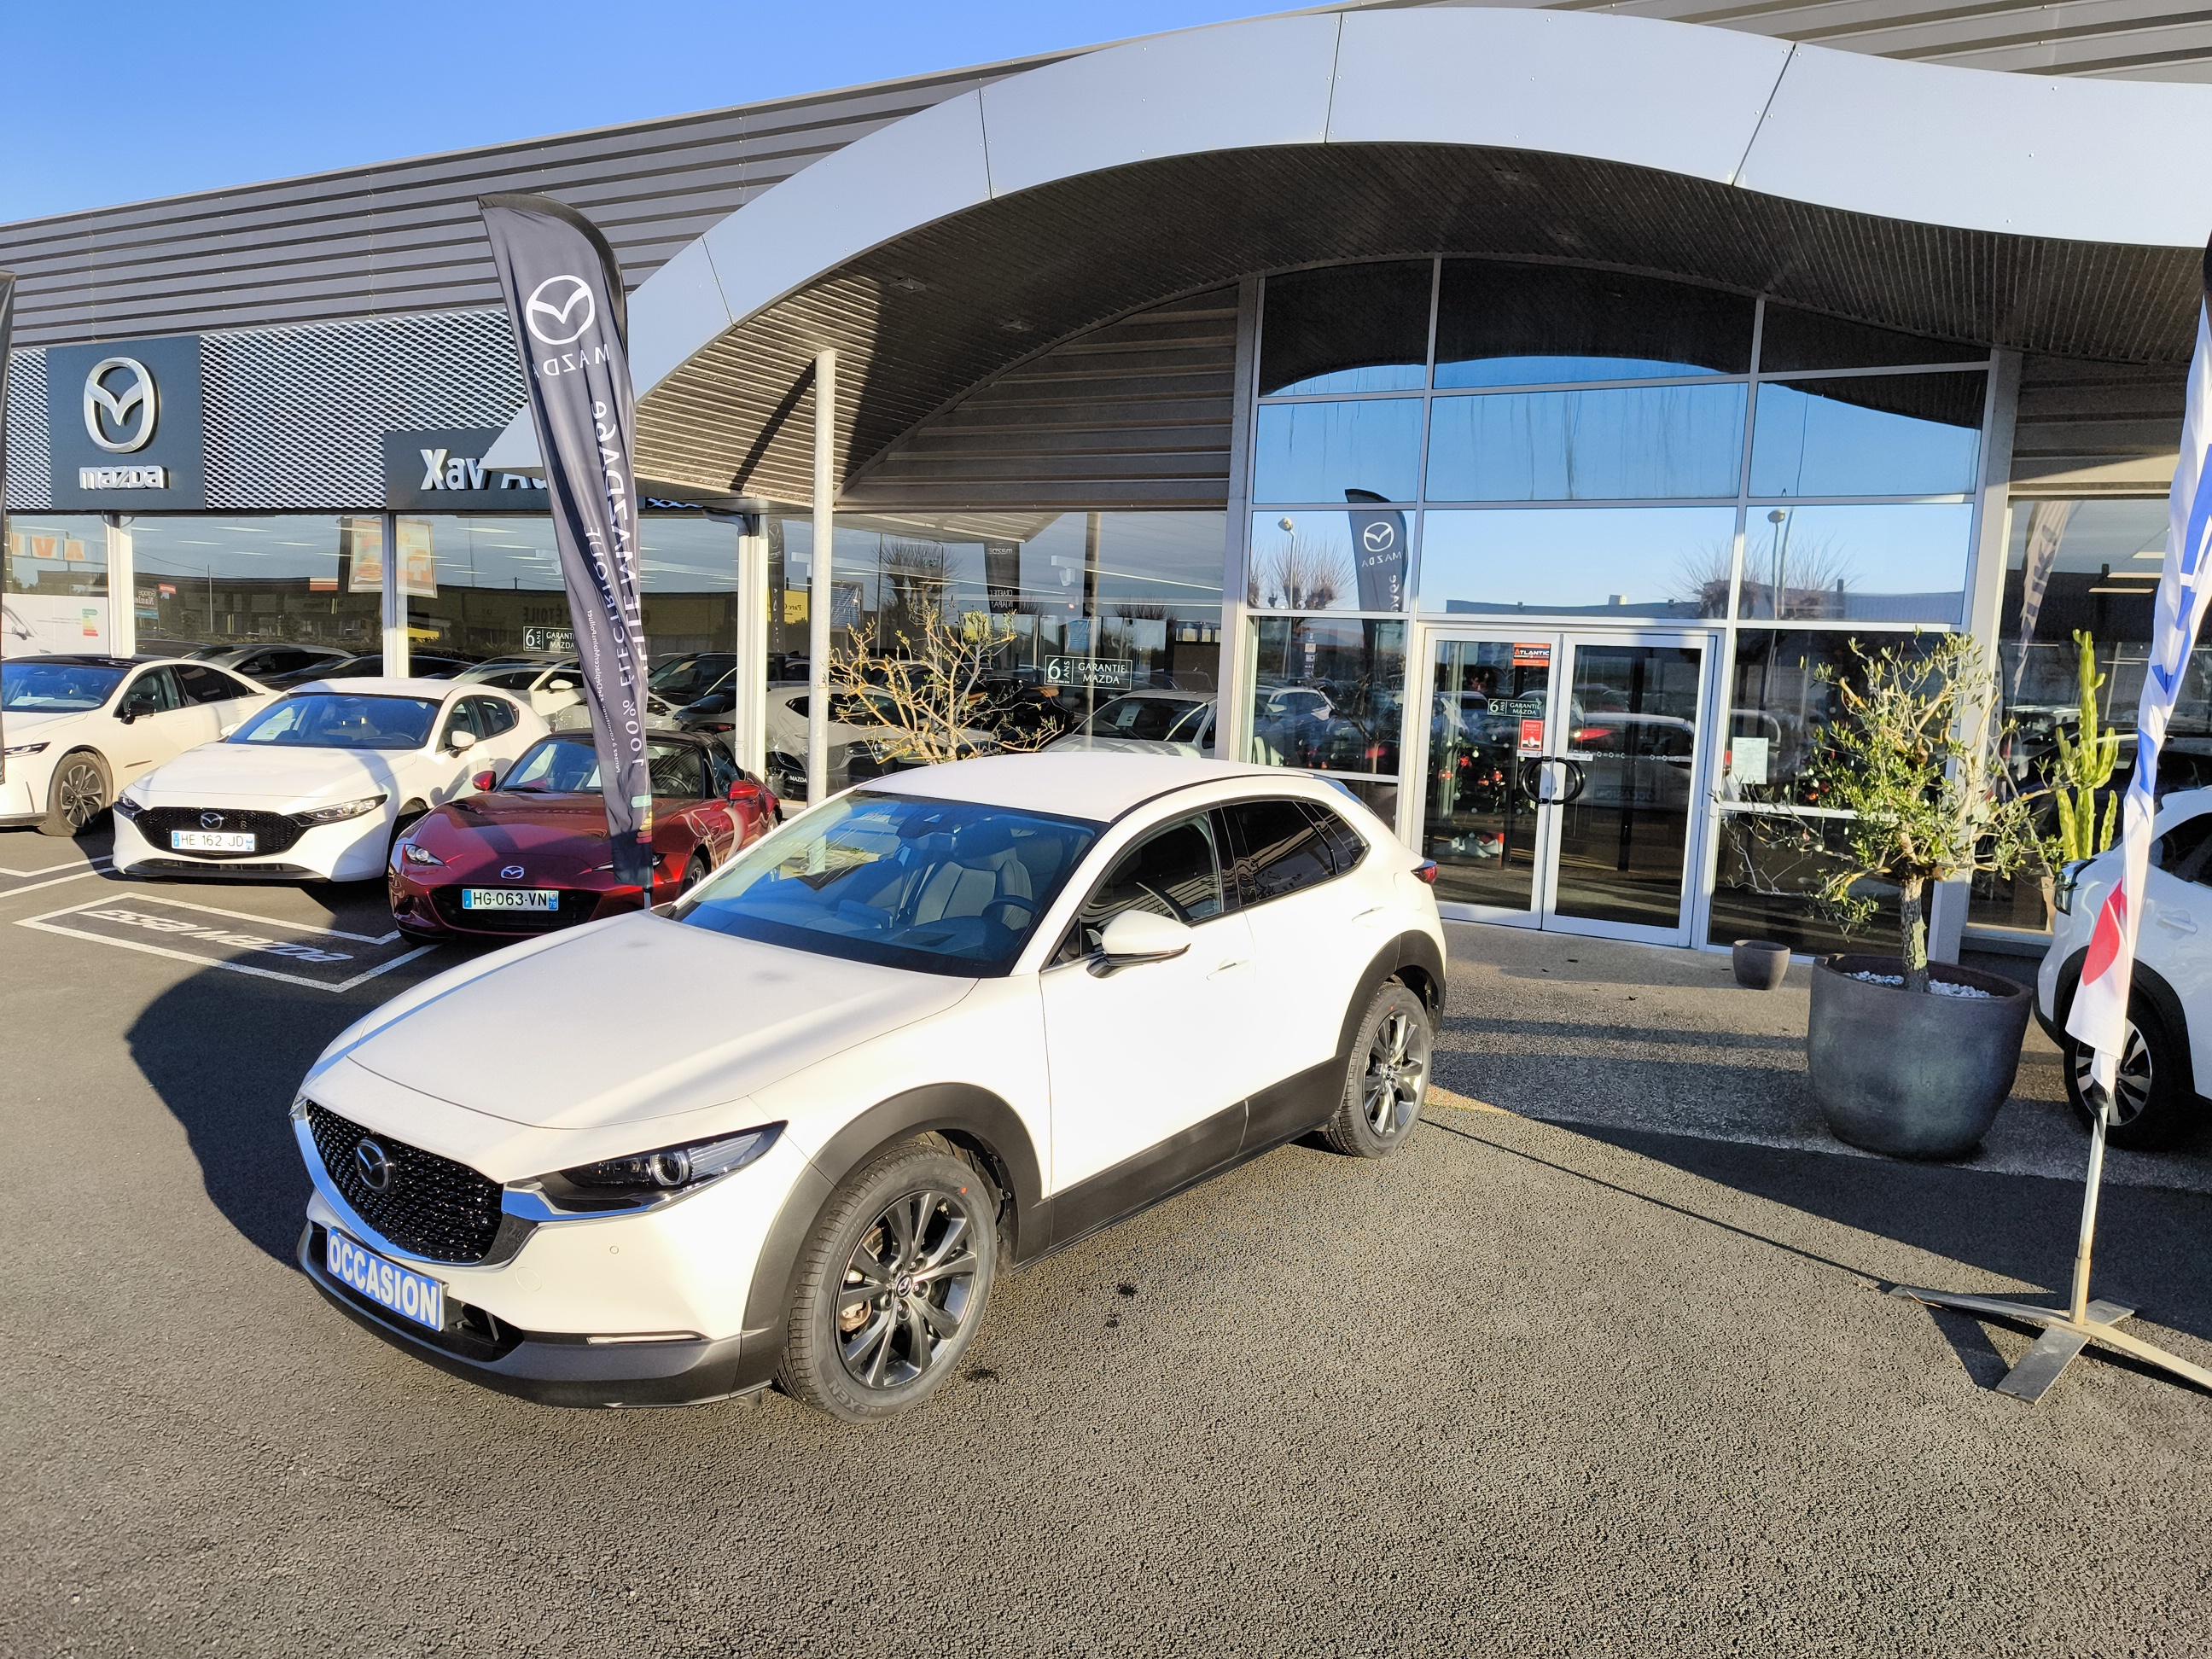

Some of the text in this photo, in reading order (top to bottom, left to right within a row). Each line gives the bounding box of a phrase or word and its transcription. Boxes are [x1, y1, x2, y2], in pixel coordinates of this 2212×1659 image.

[525, 628, 535, 647] 6
[549, 640, 575, 649] MAZDA
[1514, 648, 1550, 656] ATLANTIC
[1047, 657, 1061, 680] 6
[1078, 662, 1126, 673] GARANTIE
[1082, 673, 1120, 684] MAZDA
[1489, 700, 1499, 713] 6
[181, 834, 244, 847] HE 162 JD
[329, 1235, 437, 1326] OCCASION
